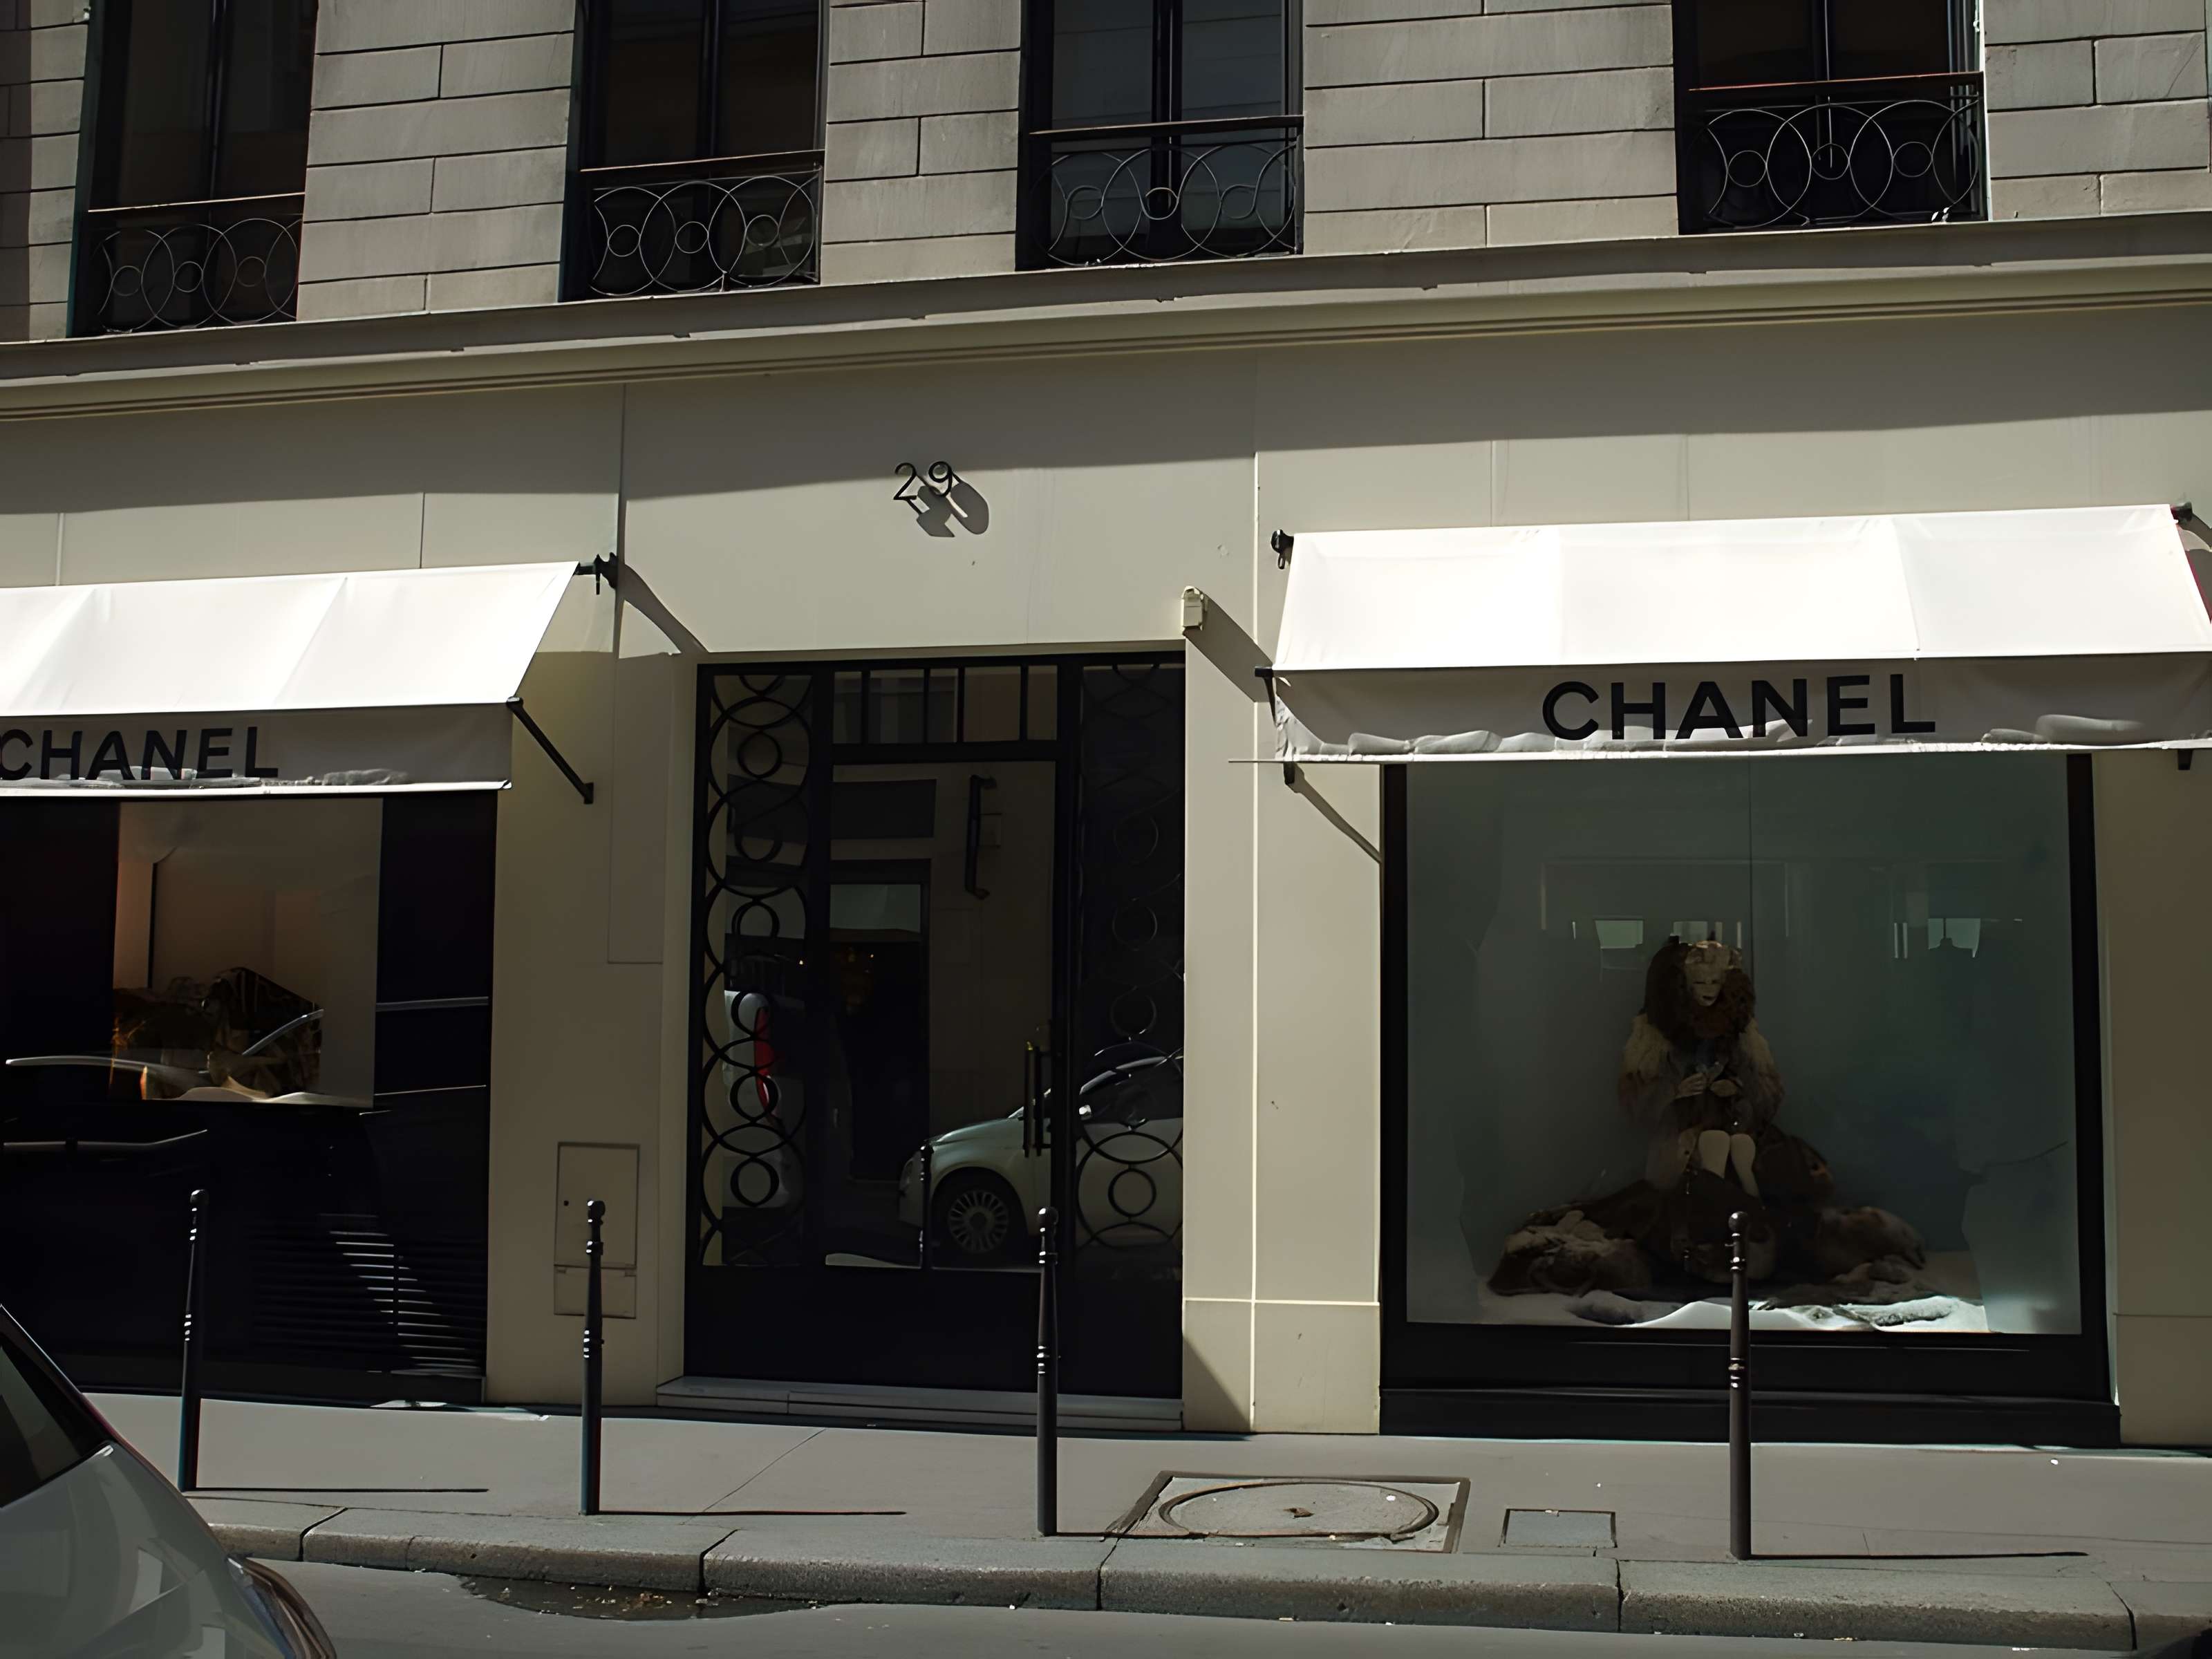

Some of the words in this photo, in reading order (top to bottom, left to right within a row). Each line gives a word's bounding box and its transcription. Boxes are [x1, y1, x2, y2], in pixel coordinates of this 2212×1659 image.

[893, 461, 953, 500] 29
[1542, 673, 1936, 741] CHANEL
[0, 727, 279, 780] CHANEL
